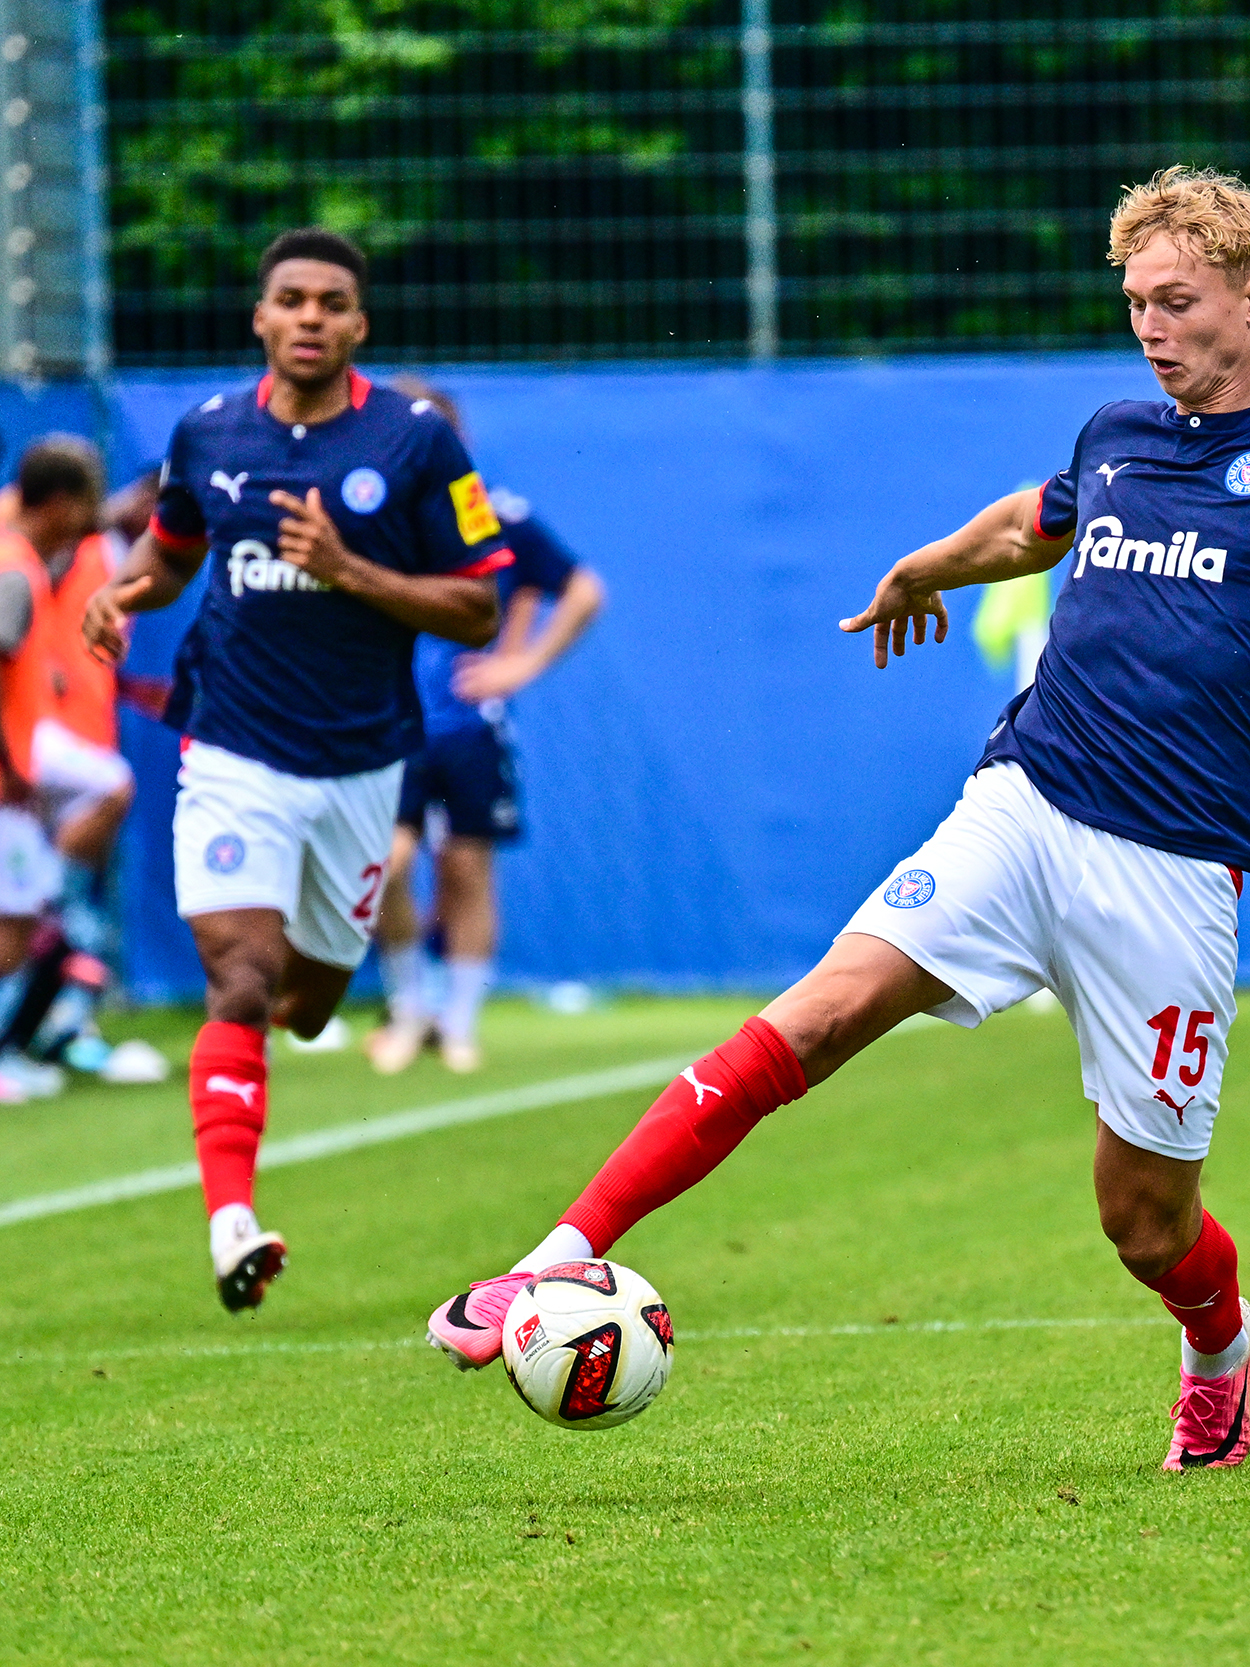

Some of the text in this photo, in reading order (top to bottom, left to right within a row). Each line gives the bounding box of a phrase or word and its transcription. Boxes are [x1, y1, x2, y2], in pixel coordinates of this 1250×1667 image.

[227, 539, 331, 597] fam
[1073, 515, 1228, 583] famila
[1147, 985, 1215, 1087] 15
